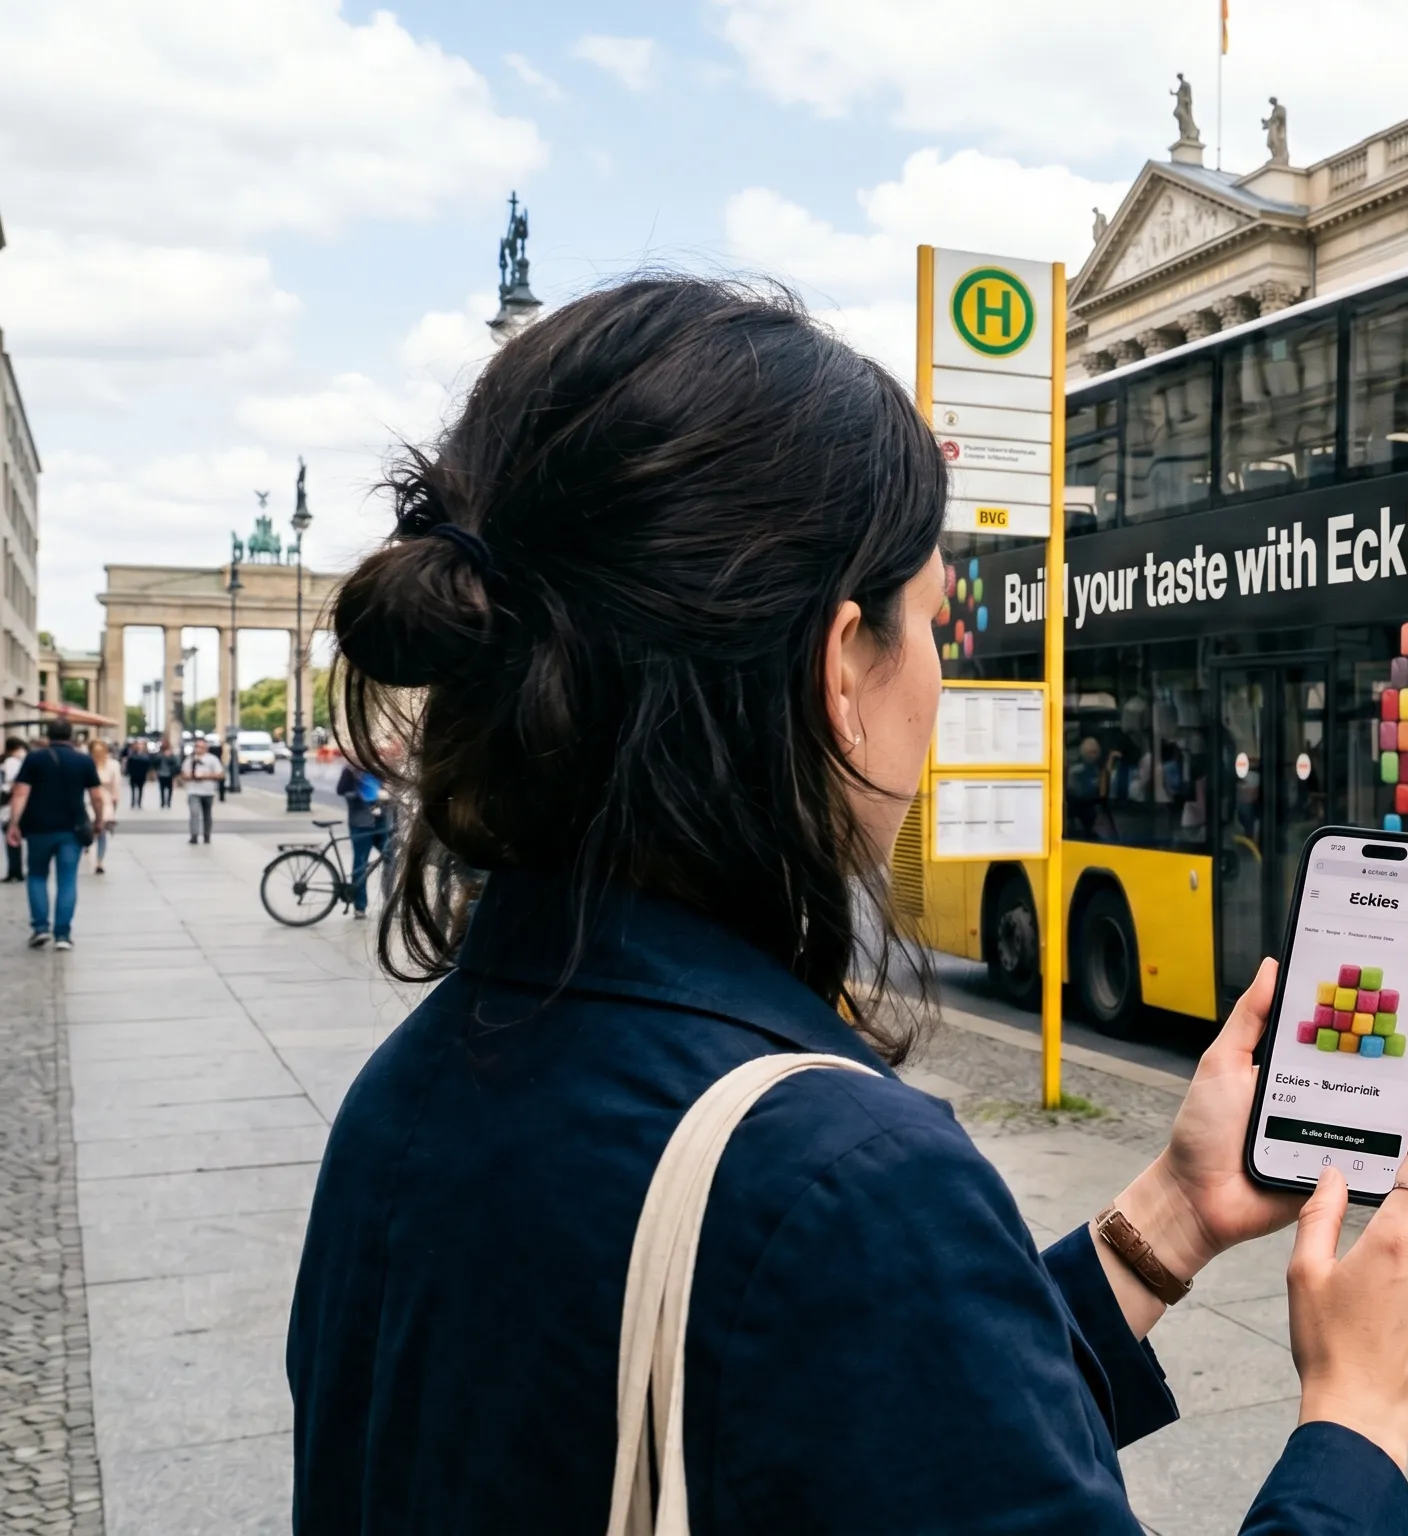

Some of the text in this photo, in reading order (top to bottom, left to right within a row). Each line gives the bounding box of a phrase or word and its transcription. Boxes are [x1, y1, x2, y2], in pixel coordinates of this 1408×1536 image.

[976, 286, 1012, 338] H
[980, 510, 1006, 525] BVG
[1073, 566, 1139, 630] your
[1143, 544, 1228, 608] taste
[1234, 521, 1317, 596] with
[1275, 1073, 1311, 1088] Eckies
[1278, 1093, 1297, 1103] 2.00
